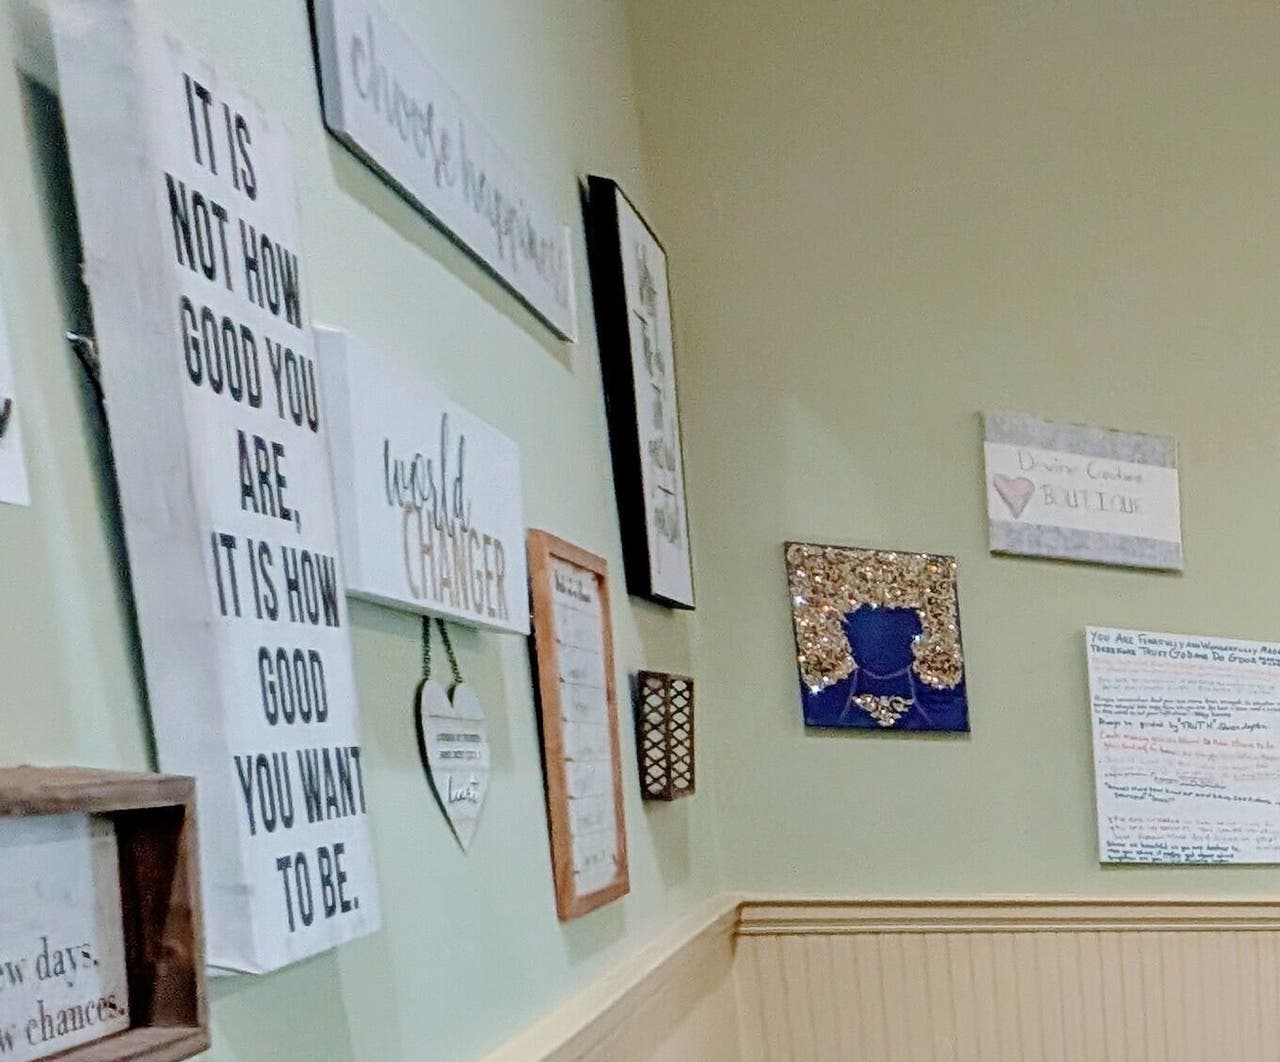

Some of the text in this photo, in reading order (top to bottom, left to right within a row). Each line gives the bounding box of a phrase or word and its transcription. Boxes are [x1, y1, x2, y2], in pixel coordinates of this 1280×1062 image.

[182, 72, 257, 201] IT IS
[165, 172, 302, 330] NOT HOW
[181, 295, 320, 433] GOOD YOU
[237, 429, 300, 534] ARE,
[384, 412, 468, 537] world
[211, 531, 340, 628] IT IS HOW
[404, 502, 509, 620] CHANGER
[258, 646, 328, 726] GOOD
[1116, 633, 1134, 644] ARE
[234, 746, 366, 836] YOU WANT
[277, 842, 358, 932] TO BE.
[26, 994, 125, 1046] chances.
